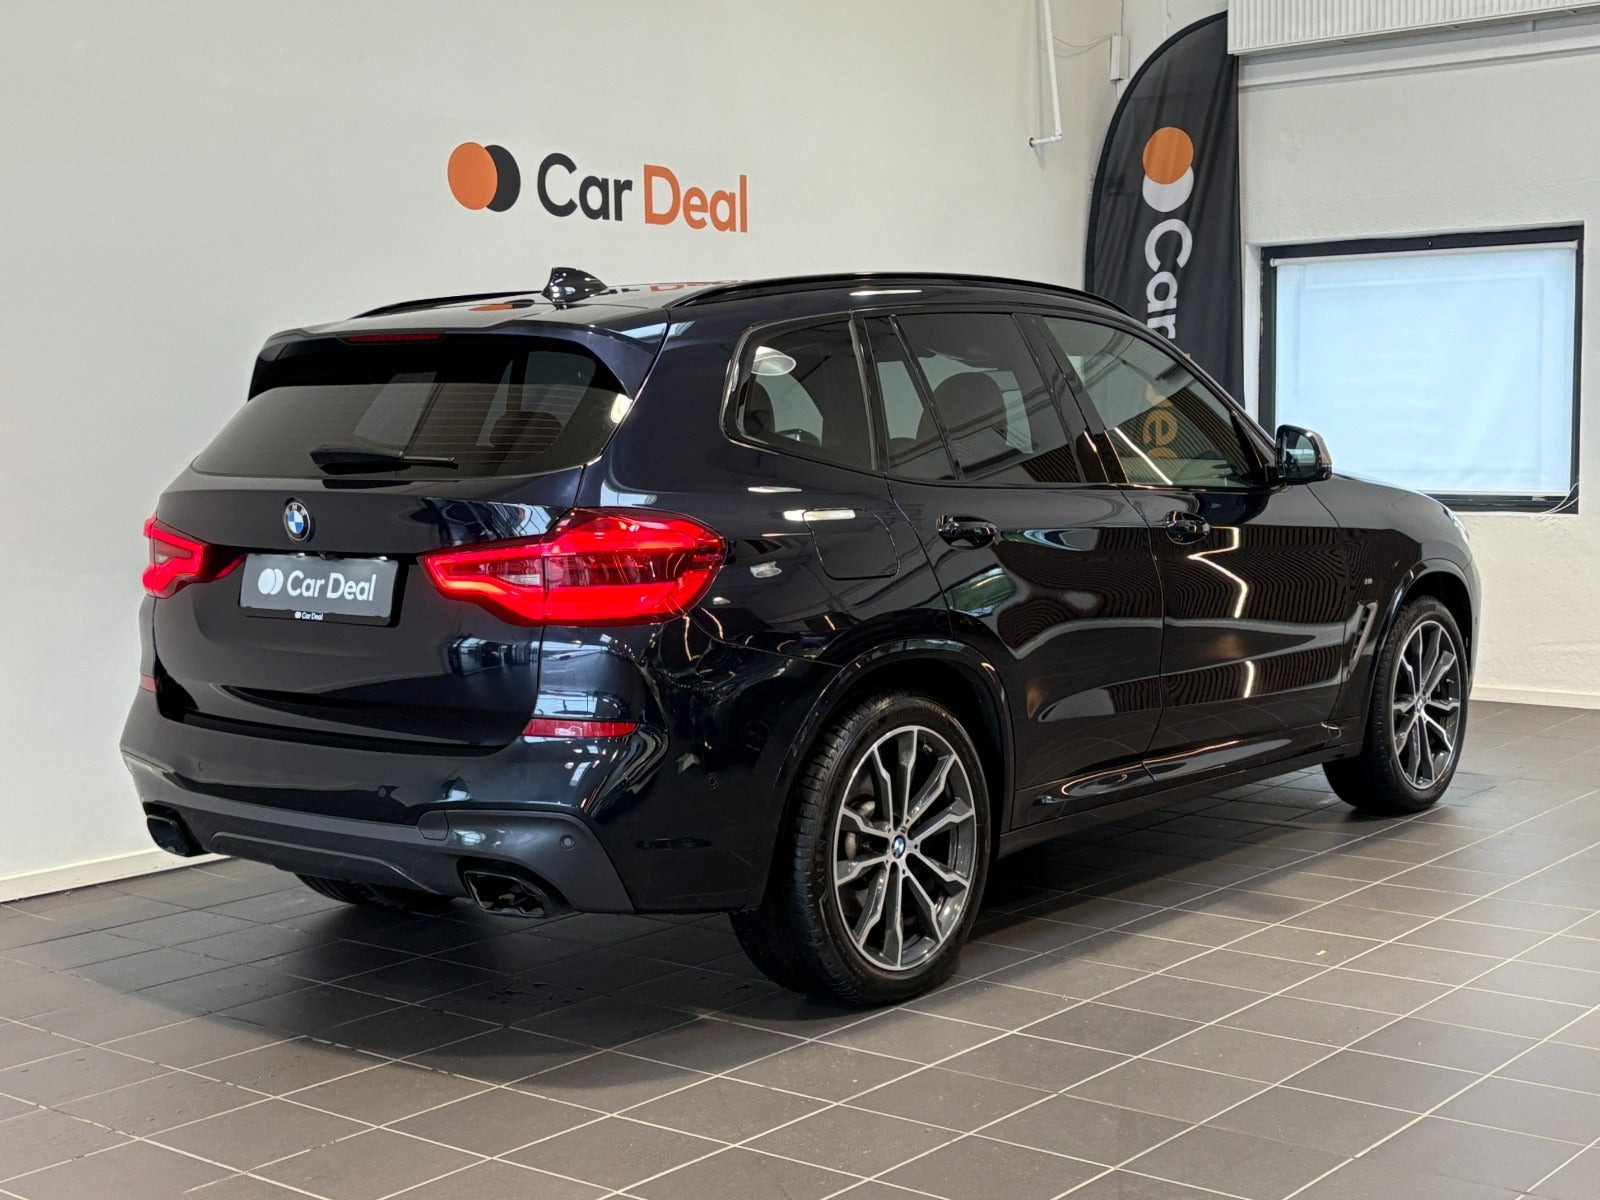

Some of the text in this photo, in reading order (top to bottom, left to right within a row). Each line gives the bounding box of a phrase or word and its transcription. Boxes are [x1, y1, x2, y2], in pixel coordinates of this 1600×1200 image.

[537, 153, 748, 233] Car Deal
[1145, 219, 1193, 339] Car
[286, 570, 377, 601] Car Deal
[301, 611, 324, 621] Car Deal
